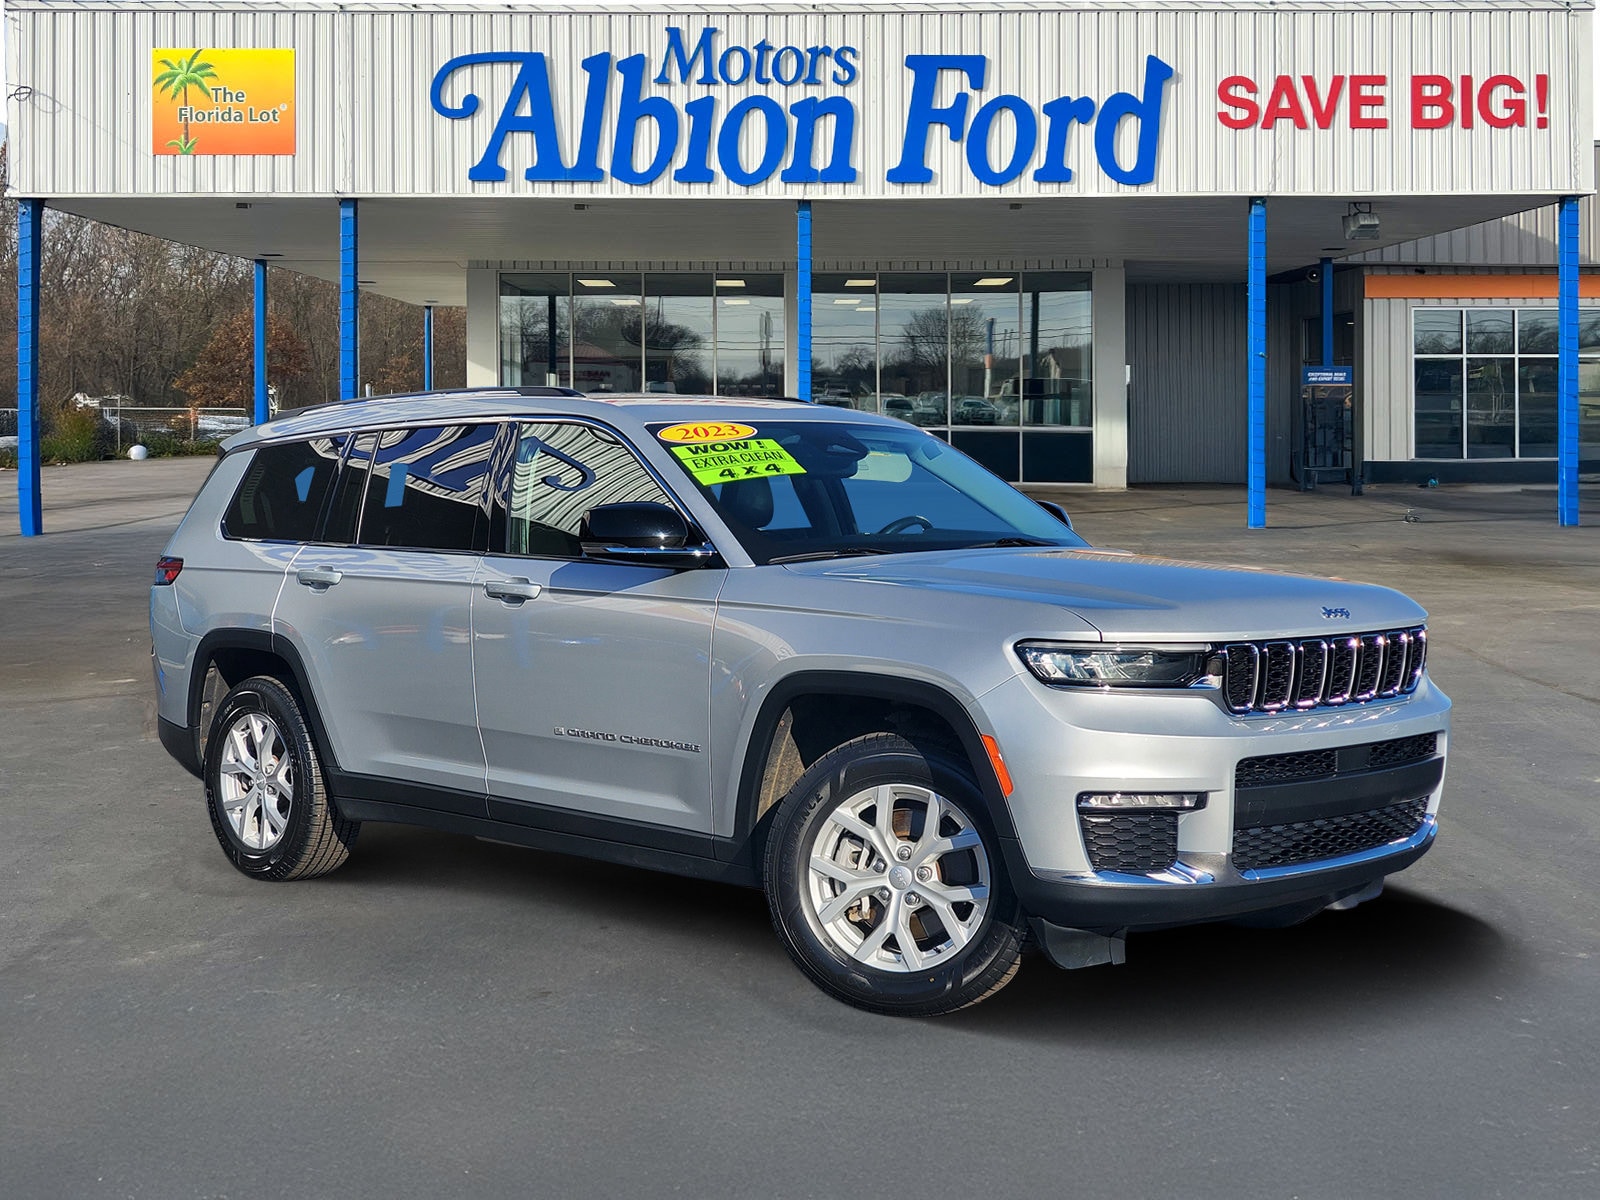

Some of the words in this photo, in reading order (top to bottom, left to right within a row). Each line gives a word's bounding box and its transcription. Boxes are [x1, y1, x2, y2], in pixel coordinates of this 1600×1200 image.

[654, 27, 857, 85] Motors
[211, 87, 246, 103] The
[1217, 74, 1388, 130] SAVE
[1410, 74, 1549, 130] BIG!
[178, 106, 243, 122] Florida
[249, 106, 280, 122] Lot
[430, 51, 857, 186] Albion
[886, 54, 1175, 186] Ford
[676, 425, 740, 440] 2023
[692, 455, 739, 469] EXTRA
[740, 450, 784, 463] CLEAN
[566, 728, 617, 742] GRAND
[619, 735, 702, 753] CHEROKEE
